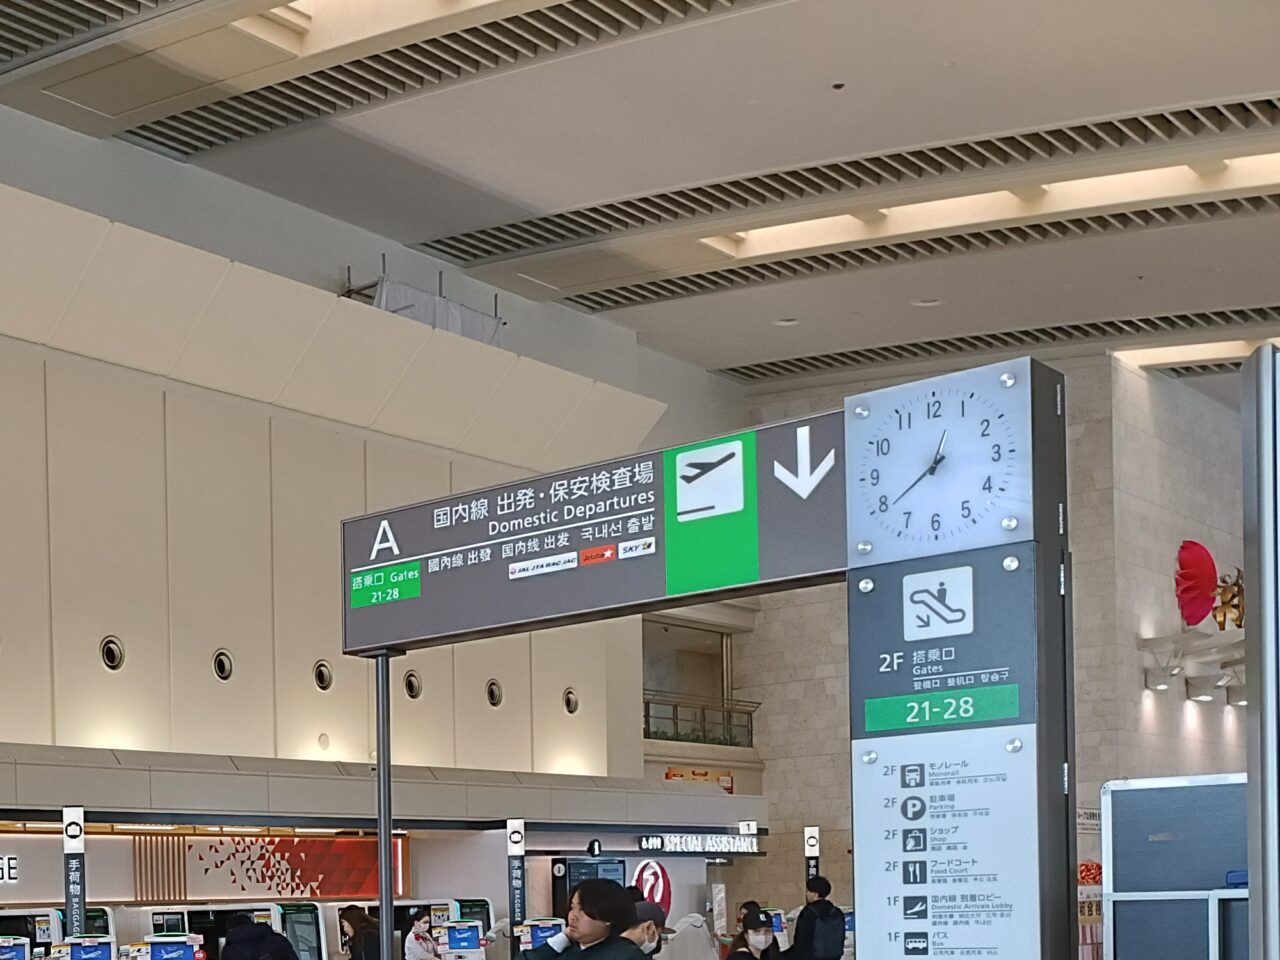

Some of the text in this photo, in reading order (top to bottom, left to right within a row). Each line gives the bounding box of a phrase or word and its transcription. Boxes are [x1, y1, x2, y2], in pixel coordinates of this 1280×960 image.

[926, 401, 941, 419] 12
[898, 412, 912, 430] 11
[980, 419, 990, 437] 2
[876, 438, 890, 456] 10
[991, 444, 1001, 461] 3
[870, 469, 880, 486] 9
[982, 475, 993, 493] 4
[489, 489, 655, 536] Domestic Departures
[879, 495, 888, 513] 8
[961, 501, 971, 518] 5
[434, 498, 489, 529] 国内線
[903, 511, 912, 529] 7
[931, 513, 941, 531] 6
[580, 514, 655, 541] 국내선 출발
[369, 519, 400, 561] A
[502, 532, 570, 558] 国内线 出发
[623, 545, 640, 554] SKY
[352, 570, 419, 590] 搭乗口 Gates
[371, 588, 399, 603] 21-28
[879, 647, 955, 672] 2F 搭乗口
[913, 664, 943, 675] Gates
[906, 697, 974, 723] 21-28
[883, 760, 969, 776] 2F モノレール
[884, 797, 898, 808] 2F
[884, 826, 959, 840] 2F ショップ
[665, 834, 703, 851] SPECIAL
[884, 859, 978, 871] 2F フードコート
[68, 859, 80, 895] 手荷物
[887, 896, 899, 906] 1F
[888, 932, 900, 942] 1F
